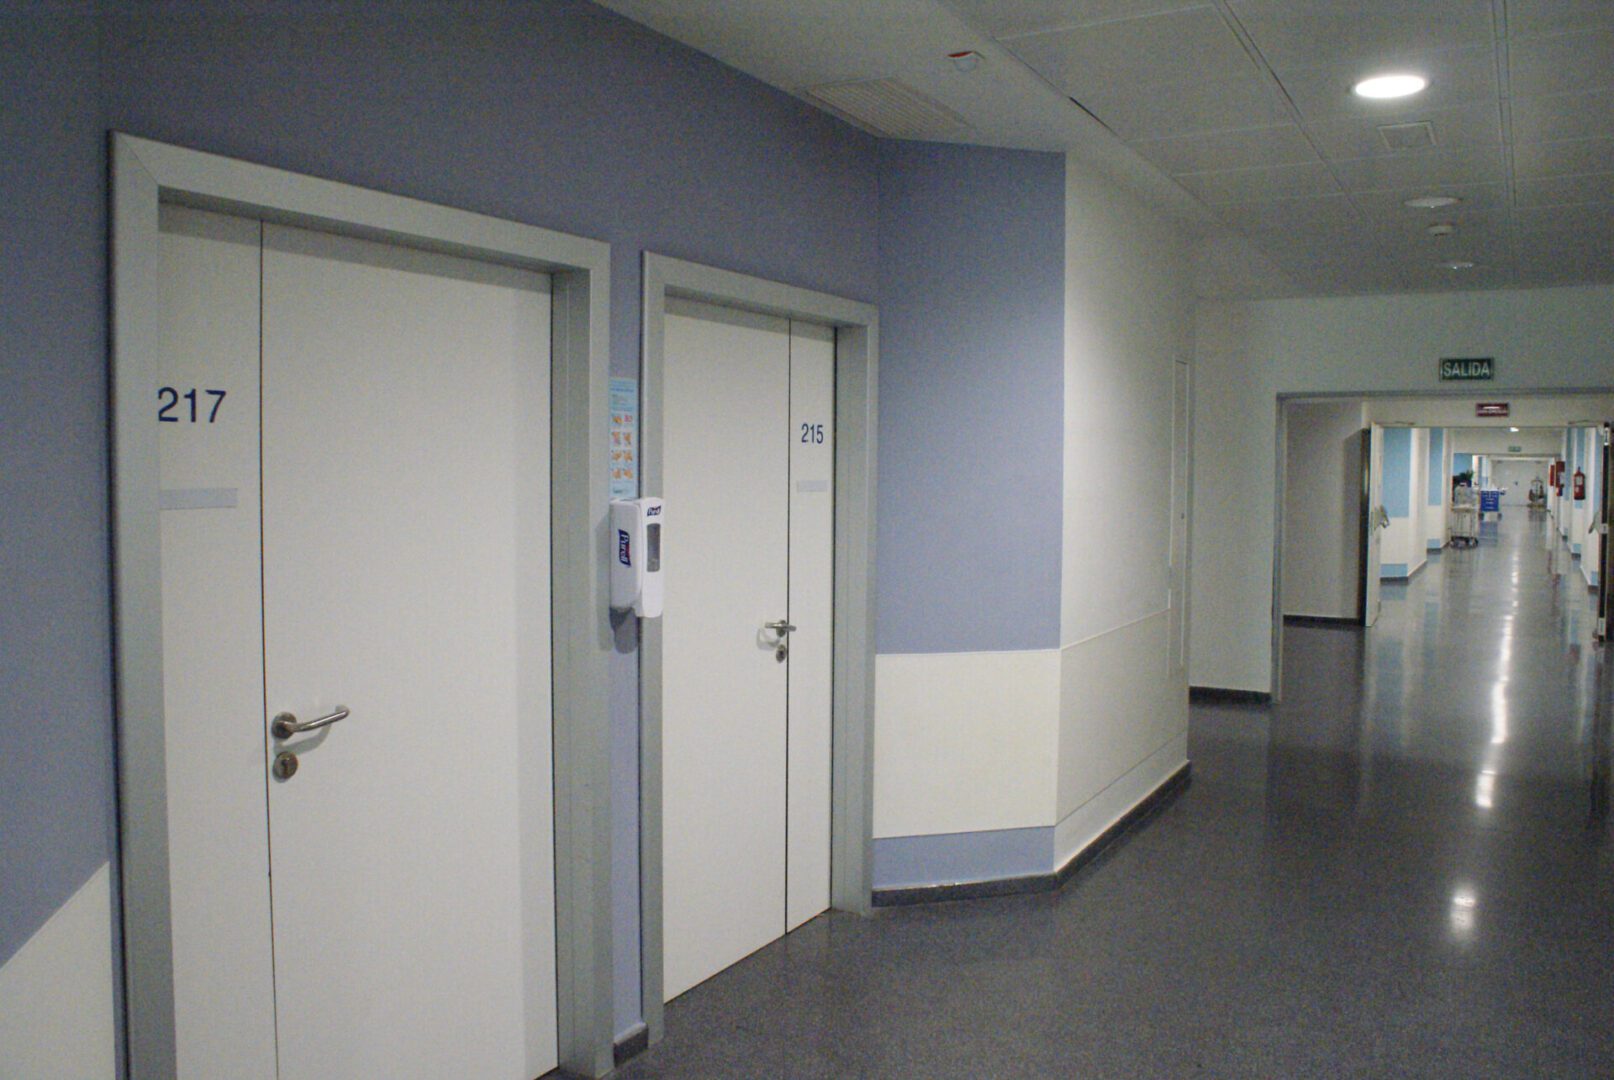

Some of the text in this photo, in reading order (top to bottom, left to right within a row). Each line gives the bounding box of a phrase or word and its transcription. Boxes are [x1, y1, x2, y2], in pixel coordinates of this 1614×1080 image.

[1443, 361, 1490, 377] SALIDA
[158, 387, 226, 423] 217
[801, 422, 824, 445] 215
